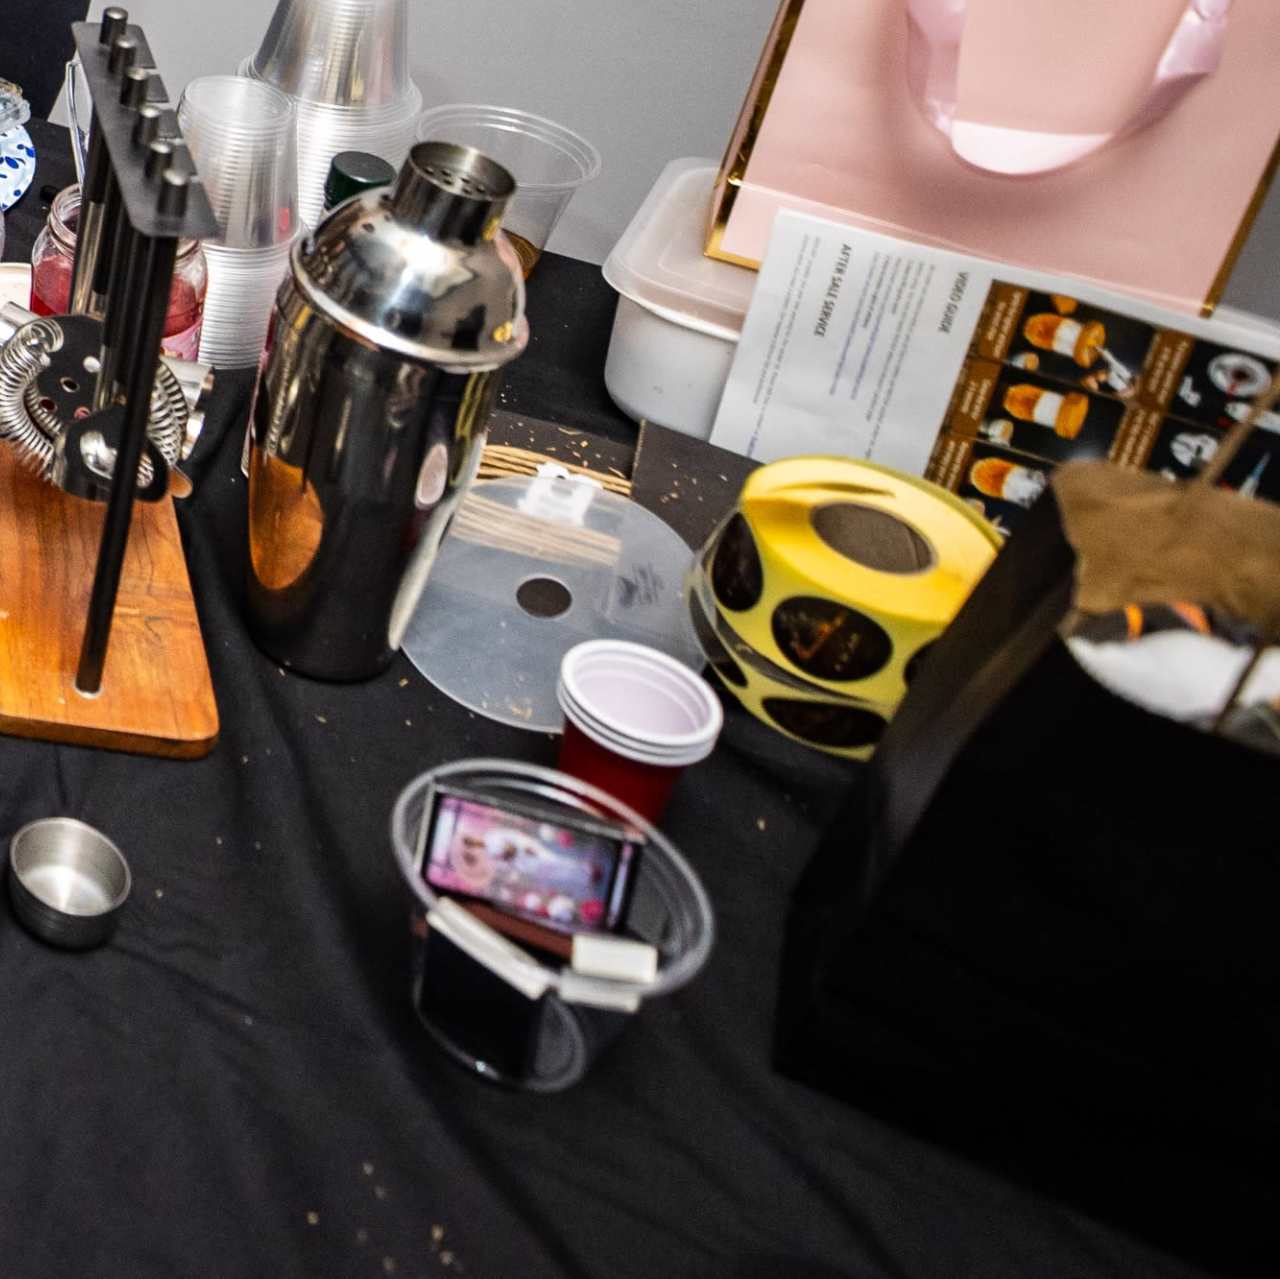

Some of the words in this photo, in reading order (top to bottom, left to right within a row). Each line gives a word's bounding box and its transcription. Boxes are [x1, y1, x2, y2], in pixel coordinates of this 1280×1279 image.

[834, 243, 852, 275] AFTER
[826, 276, 843, 300] SALE
[947, 271, 969, 302] VIDEO
[813, 300, 836, 338] SERVICE
